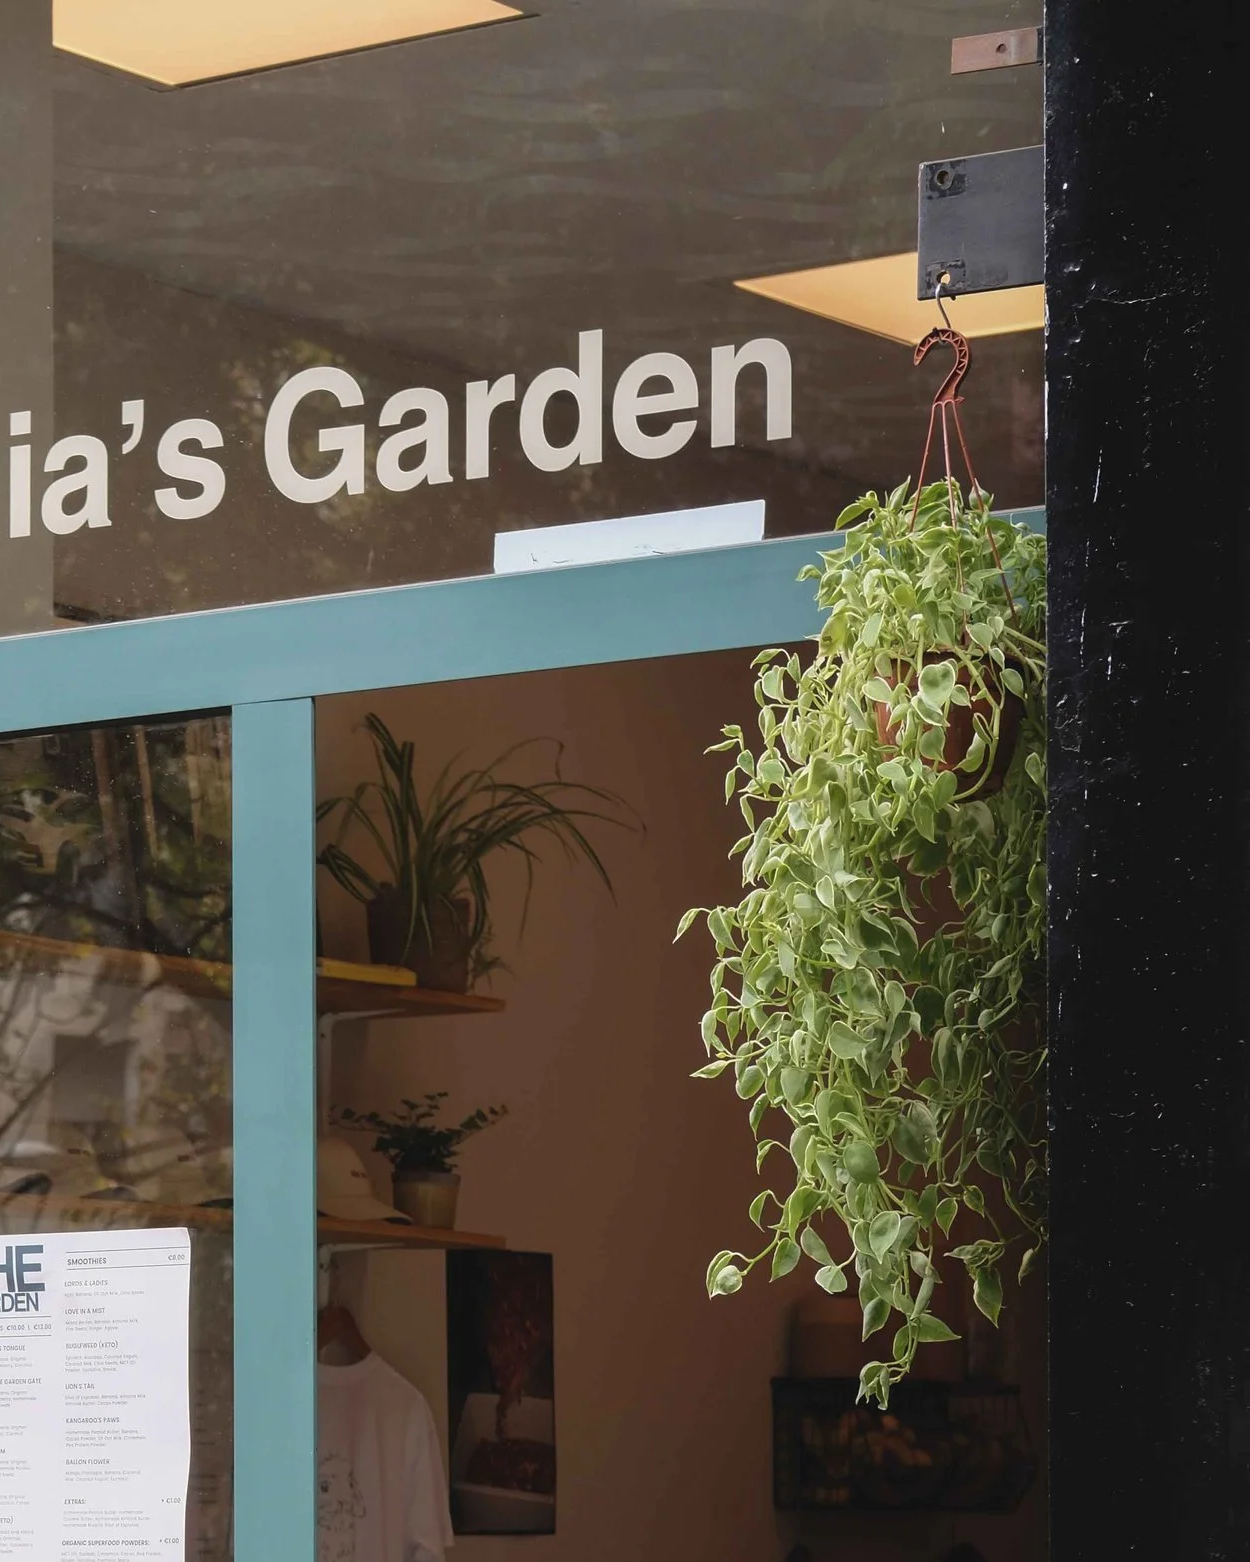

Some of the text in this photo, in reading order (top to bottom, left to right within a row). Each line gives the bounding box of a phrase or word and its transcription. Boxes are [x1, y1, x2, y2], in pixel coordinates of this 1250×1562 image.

[263, 329, 793, 504] Garden
[67, 1257, 107, 1266] SMOOTHIES
[98, 1340, 119, 1349] (KETO)
[61, 1539, 87, 1547] ORGANIC
[87, 1539, 121, 1547] SUPERFOOD
[121, 1539, 151, 1547] POWDERS:
